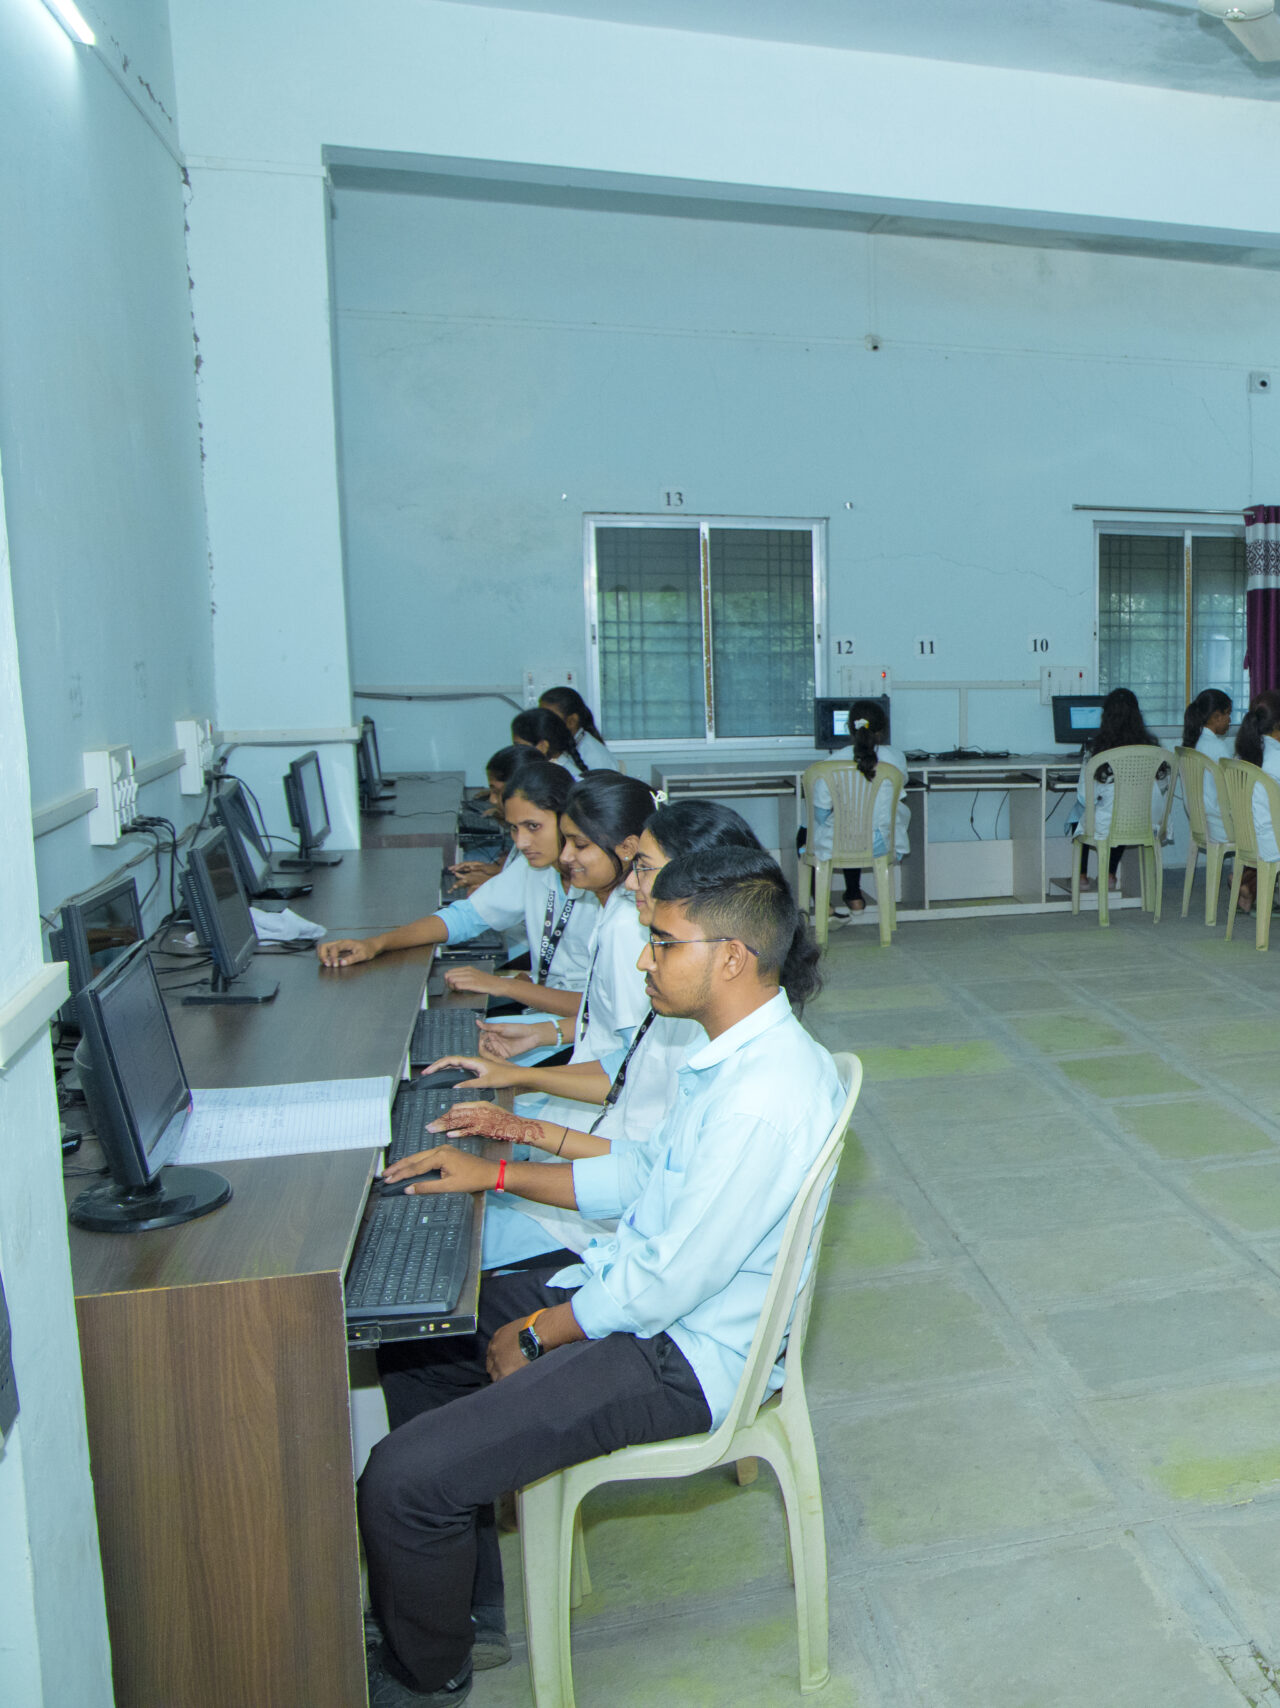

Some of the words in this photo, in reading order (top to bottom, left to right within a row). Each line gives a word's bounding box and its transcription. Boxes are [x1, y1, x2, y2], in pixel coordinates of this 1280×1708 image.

[664, 491, 684, 507] 13
[836, 640, 854, 654] 12
[919, 640, 935, 654] 11
[1032, 638, 1049, 652] 10
[560, 900, 573, 923] JCOP
[545, 943, 555, 964] JCOP
